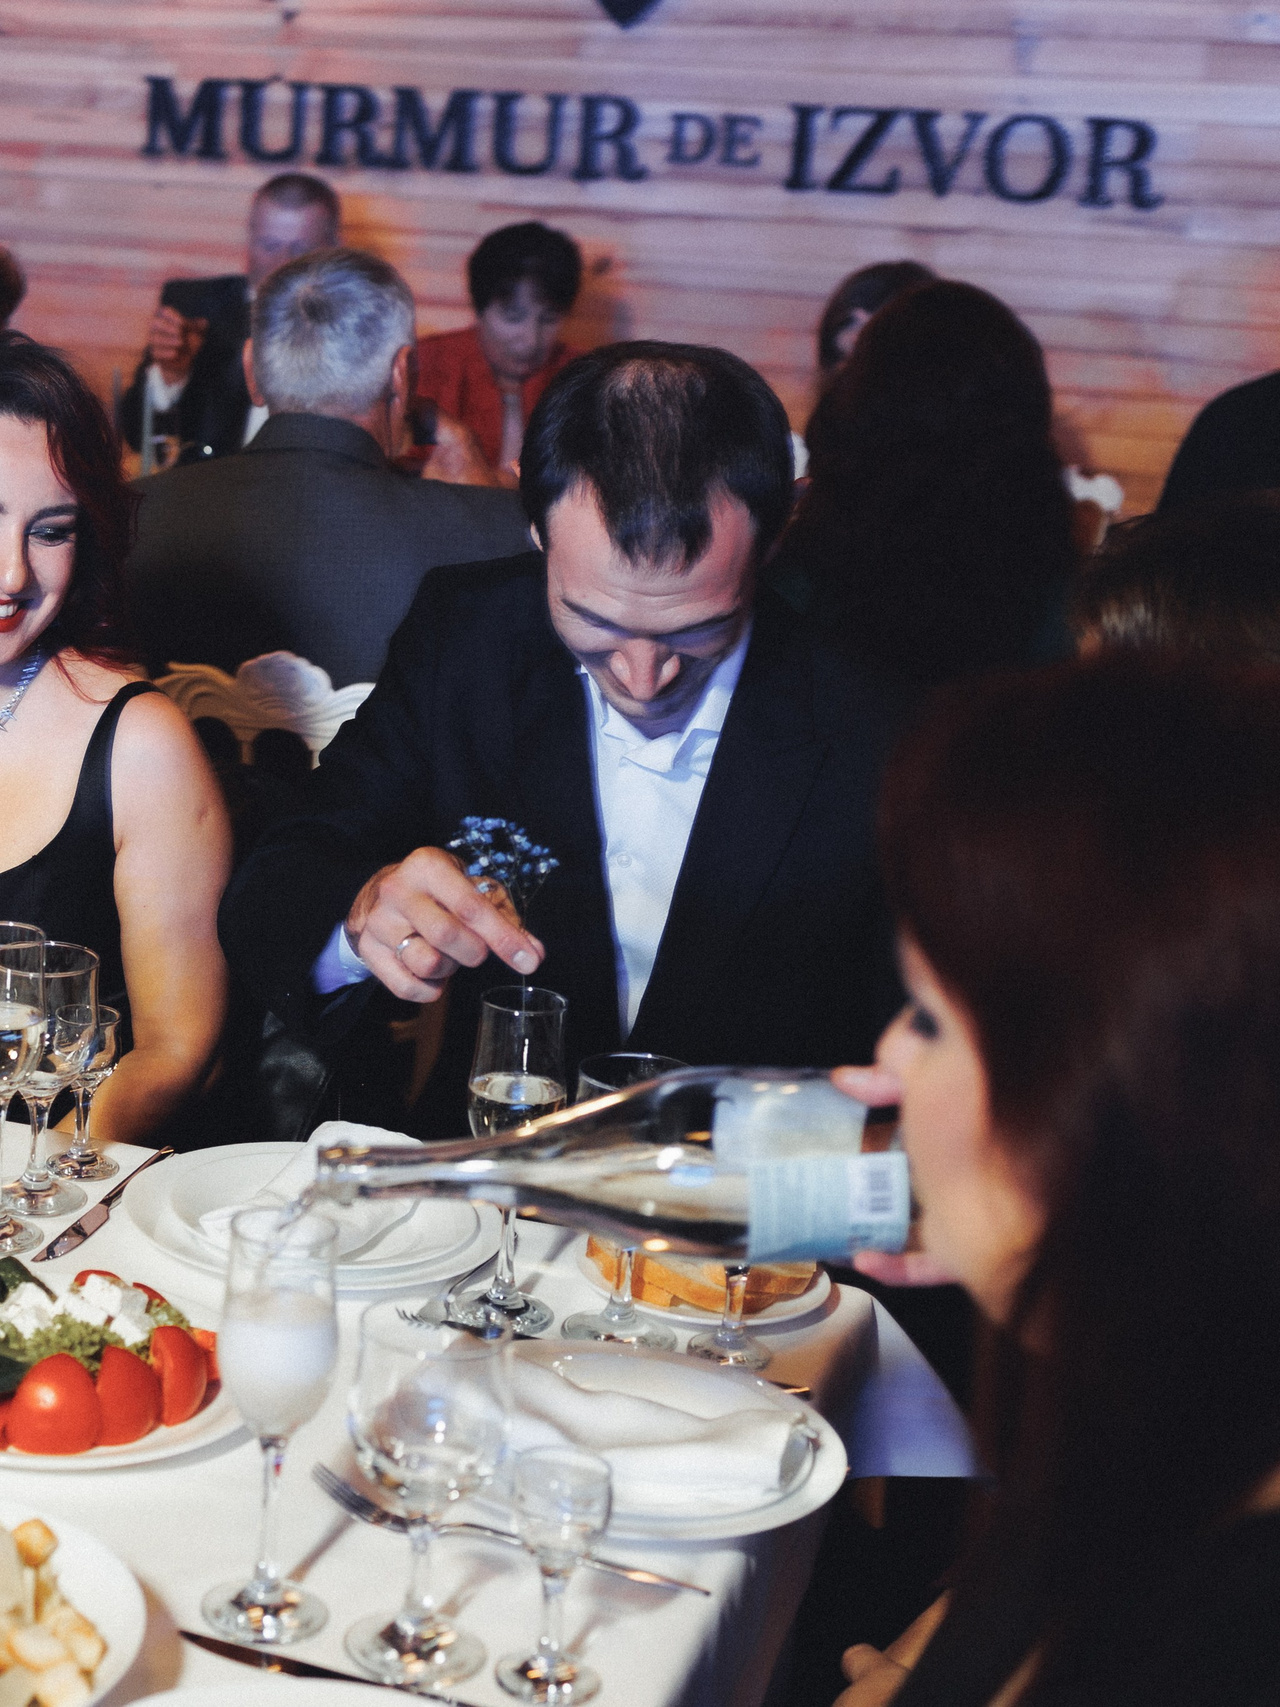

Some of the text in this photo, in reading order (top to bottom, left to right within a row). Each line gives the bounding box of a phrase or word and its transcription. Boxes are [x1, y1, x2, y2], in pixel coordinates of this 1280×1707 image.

[141, 75, 1166, 210] MURMUR DE IZVOR
